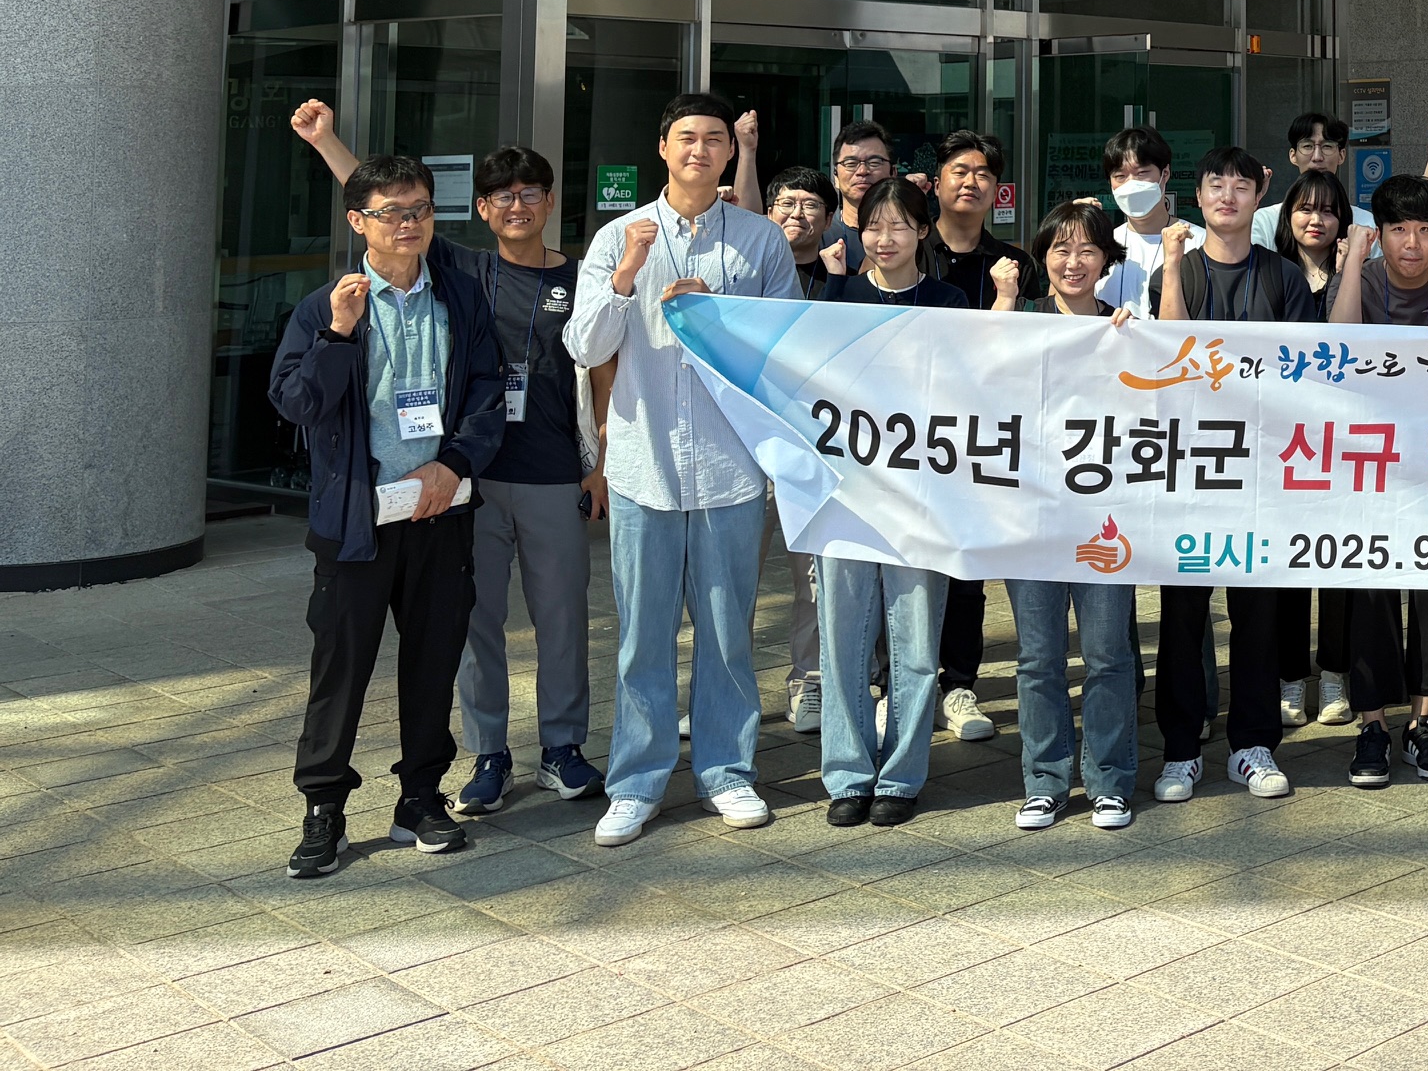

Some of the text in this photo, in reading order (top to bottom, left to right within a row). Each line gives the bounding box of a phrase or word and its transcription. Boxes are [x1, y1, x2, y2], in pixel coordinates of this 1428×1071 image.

[614, 189, 632, 199] AED
[1118, 335, 1266, 392] 소통과
[1278, 341, 1407, 383] 화합으로
[811, 399, 1023, 489] 2025년
[1061, 415, 1251, 496] 강화군
[1277, 420, 1401, 493] 신규
[1174, 531, 1270, 574] 일시:
